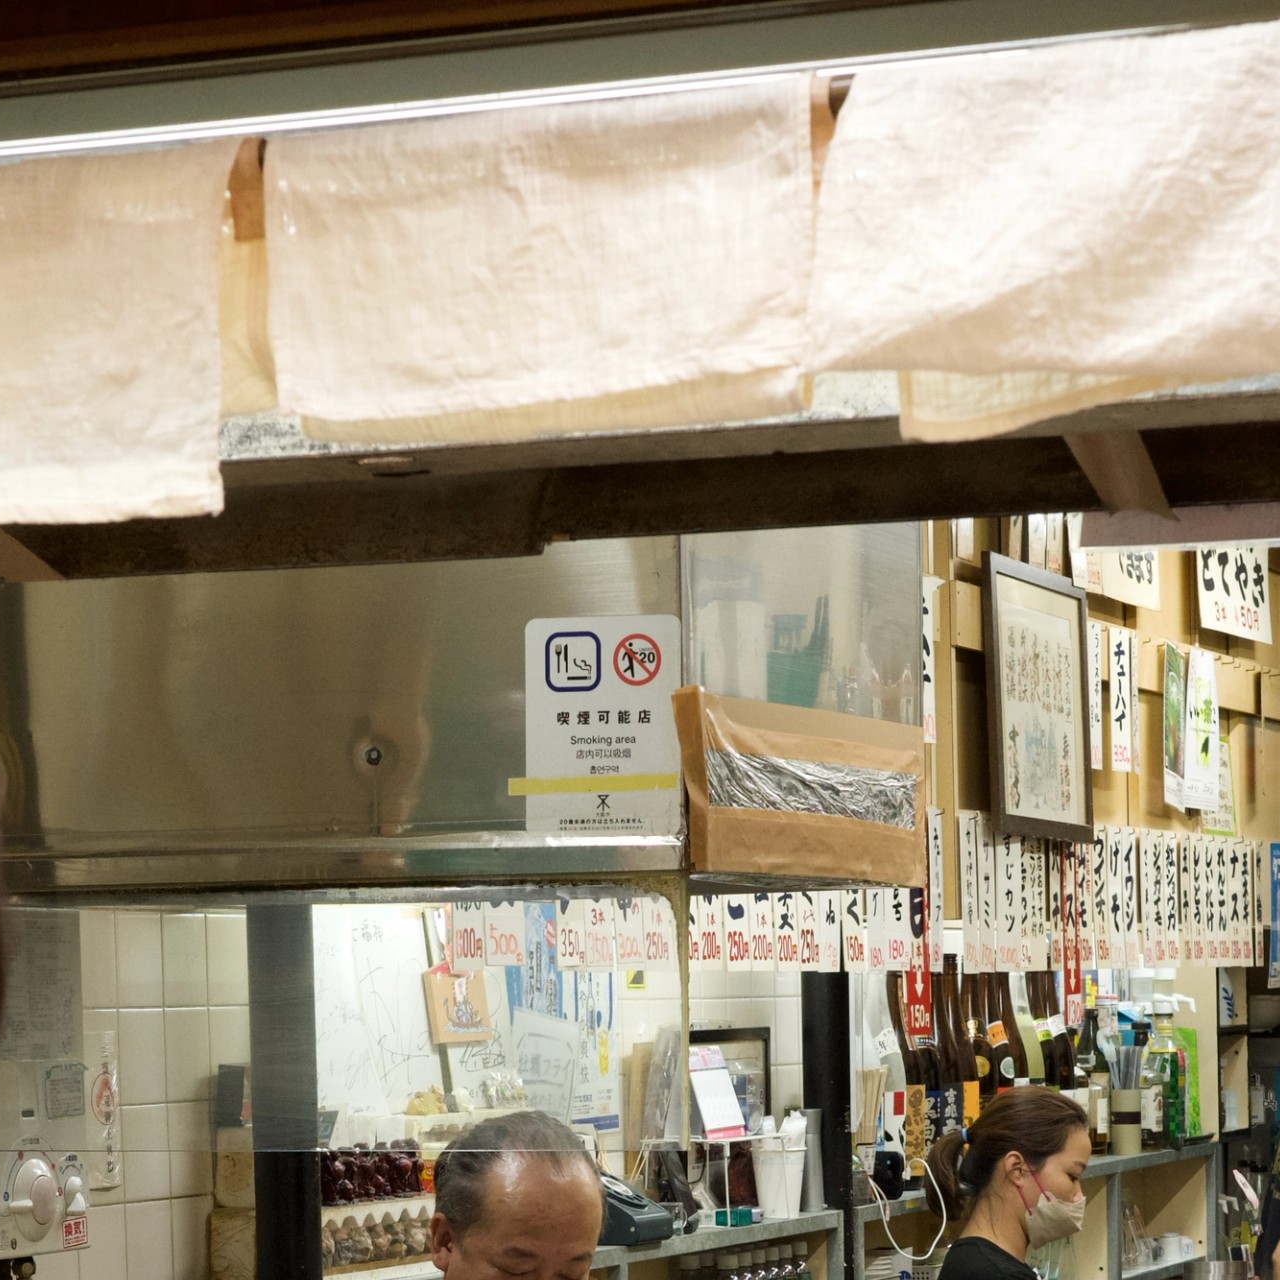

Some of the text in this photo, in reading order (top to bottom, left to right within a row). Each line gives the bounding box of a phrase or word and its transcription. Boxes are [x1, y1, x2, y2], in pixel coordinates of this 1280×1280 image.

[640, 652, 656, 664] 20
[1114, 642, 1128, 731] チューハイ
[557, 710, 651, 726] 喫煙可能店
[570, 736, 636, 746] Smoking area
[576, 749, 631, 759] 店内可以吸烟
[1003, 834, 1015, 932] すじカツ
[1093, 836, 1107, 922] ウインナー
[1109, 840, 1121, 933] げそ
[1124, 841, 1135, 932] イワシ
[1193, 846, 1201, 924] ししとう
[1205, 846, 1214, 932] しいたけ
[1218, 848, 1227, 932] れんこん
[1230, 849, 1239, 923] ナス
[490, 923, 523, 962] 500円
[561, 928, 585, 963] 350円
[646, 932, 669, 960] 250円
[702, 932, 720, 960] 200円
[727, 931, 750, 961] 250円
[752, 934, 773, 961] 200円
[777, 934, 798, 962] 200円
[800, 929, 820, 963] 250円
[846, 935, 863, 962] 150円
[910, 1005, 930, 1028] 150円
